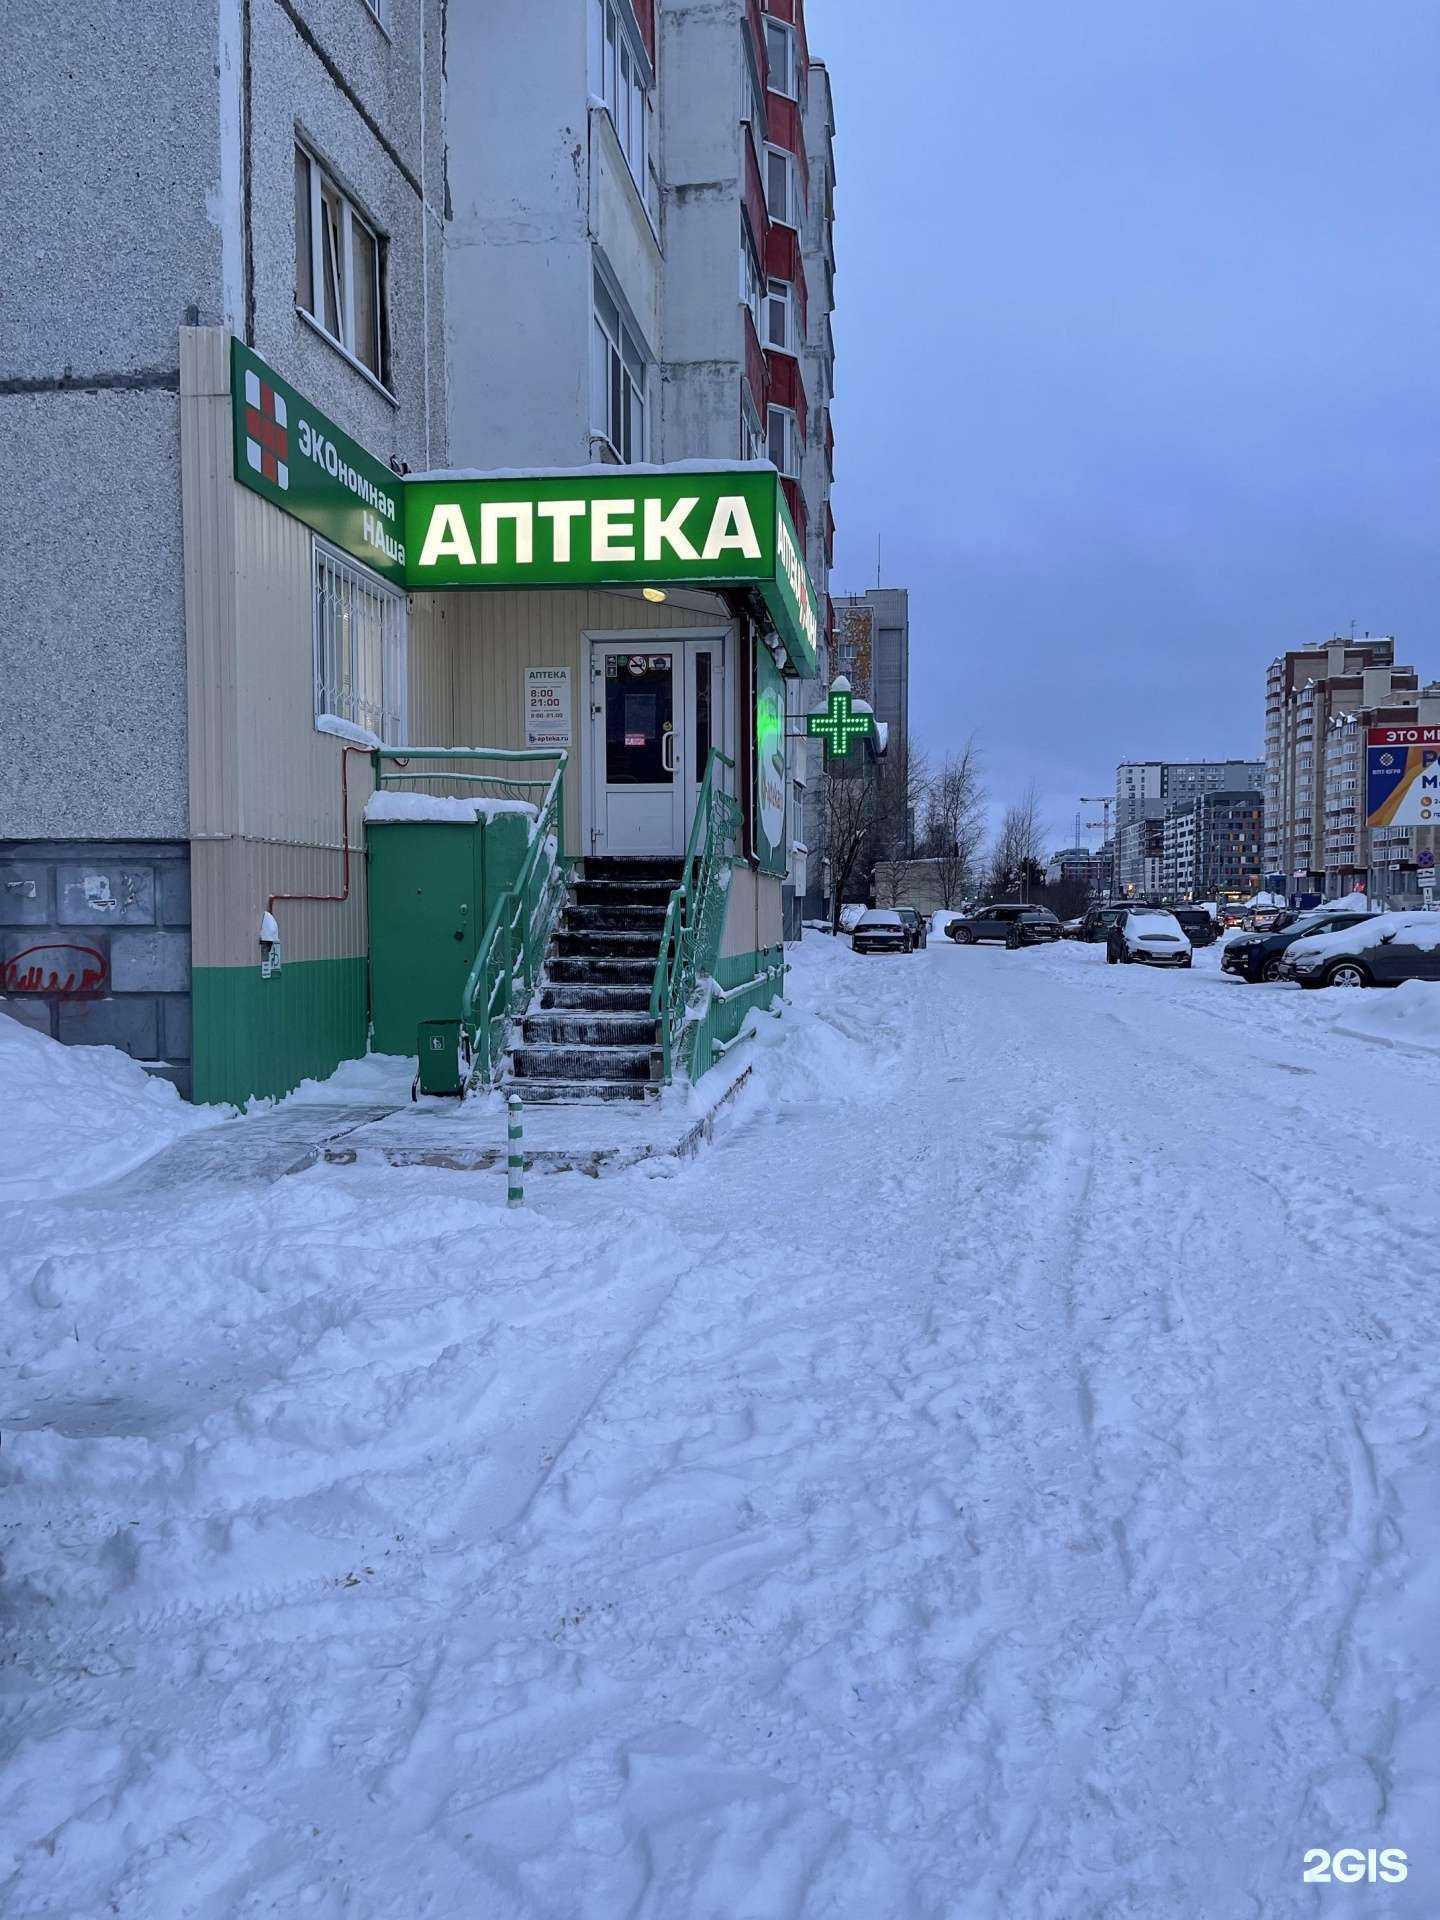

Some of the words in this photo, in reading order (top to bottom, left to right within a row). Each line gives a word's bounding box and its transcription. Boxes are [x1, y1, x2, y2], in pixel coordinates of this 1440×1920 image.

[298, 419, 395, 522] ЭКОномная
[418, 496, 762, 565] АПТЕКА
[363, 511, 406, 567] НАша
[529, 671, 567, 679] АПТЕКА
[530, 689, 553, 697] 8:00
[530, 698, 560, 707] 21:00
[1386, 730, 1418, 742] ЭТО
[1422, 750, 1440, 768] Р
[1422, 775, 1440, 789] М
